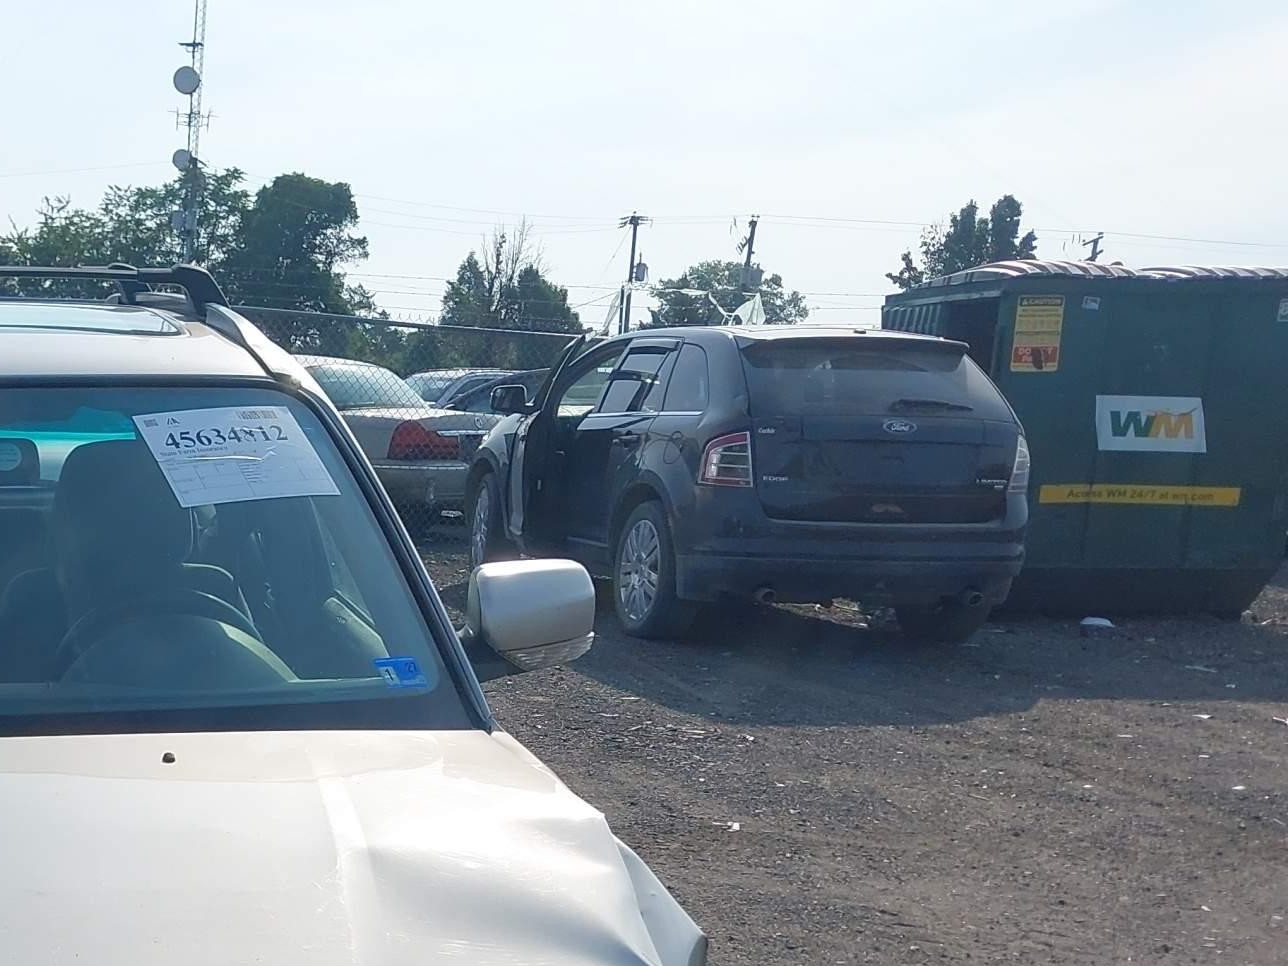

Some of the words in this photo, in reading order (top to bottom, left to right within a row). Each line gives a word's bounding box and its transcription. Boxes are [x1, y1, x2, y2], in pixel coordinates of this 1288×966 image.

[1110, 409, 1195, 439] WM
[1106, 489, 1127, 498] WM
[1129, 489, 1157, 499] 24/7
